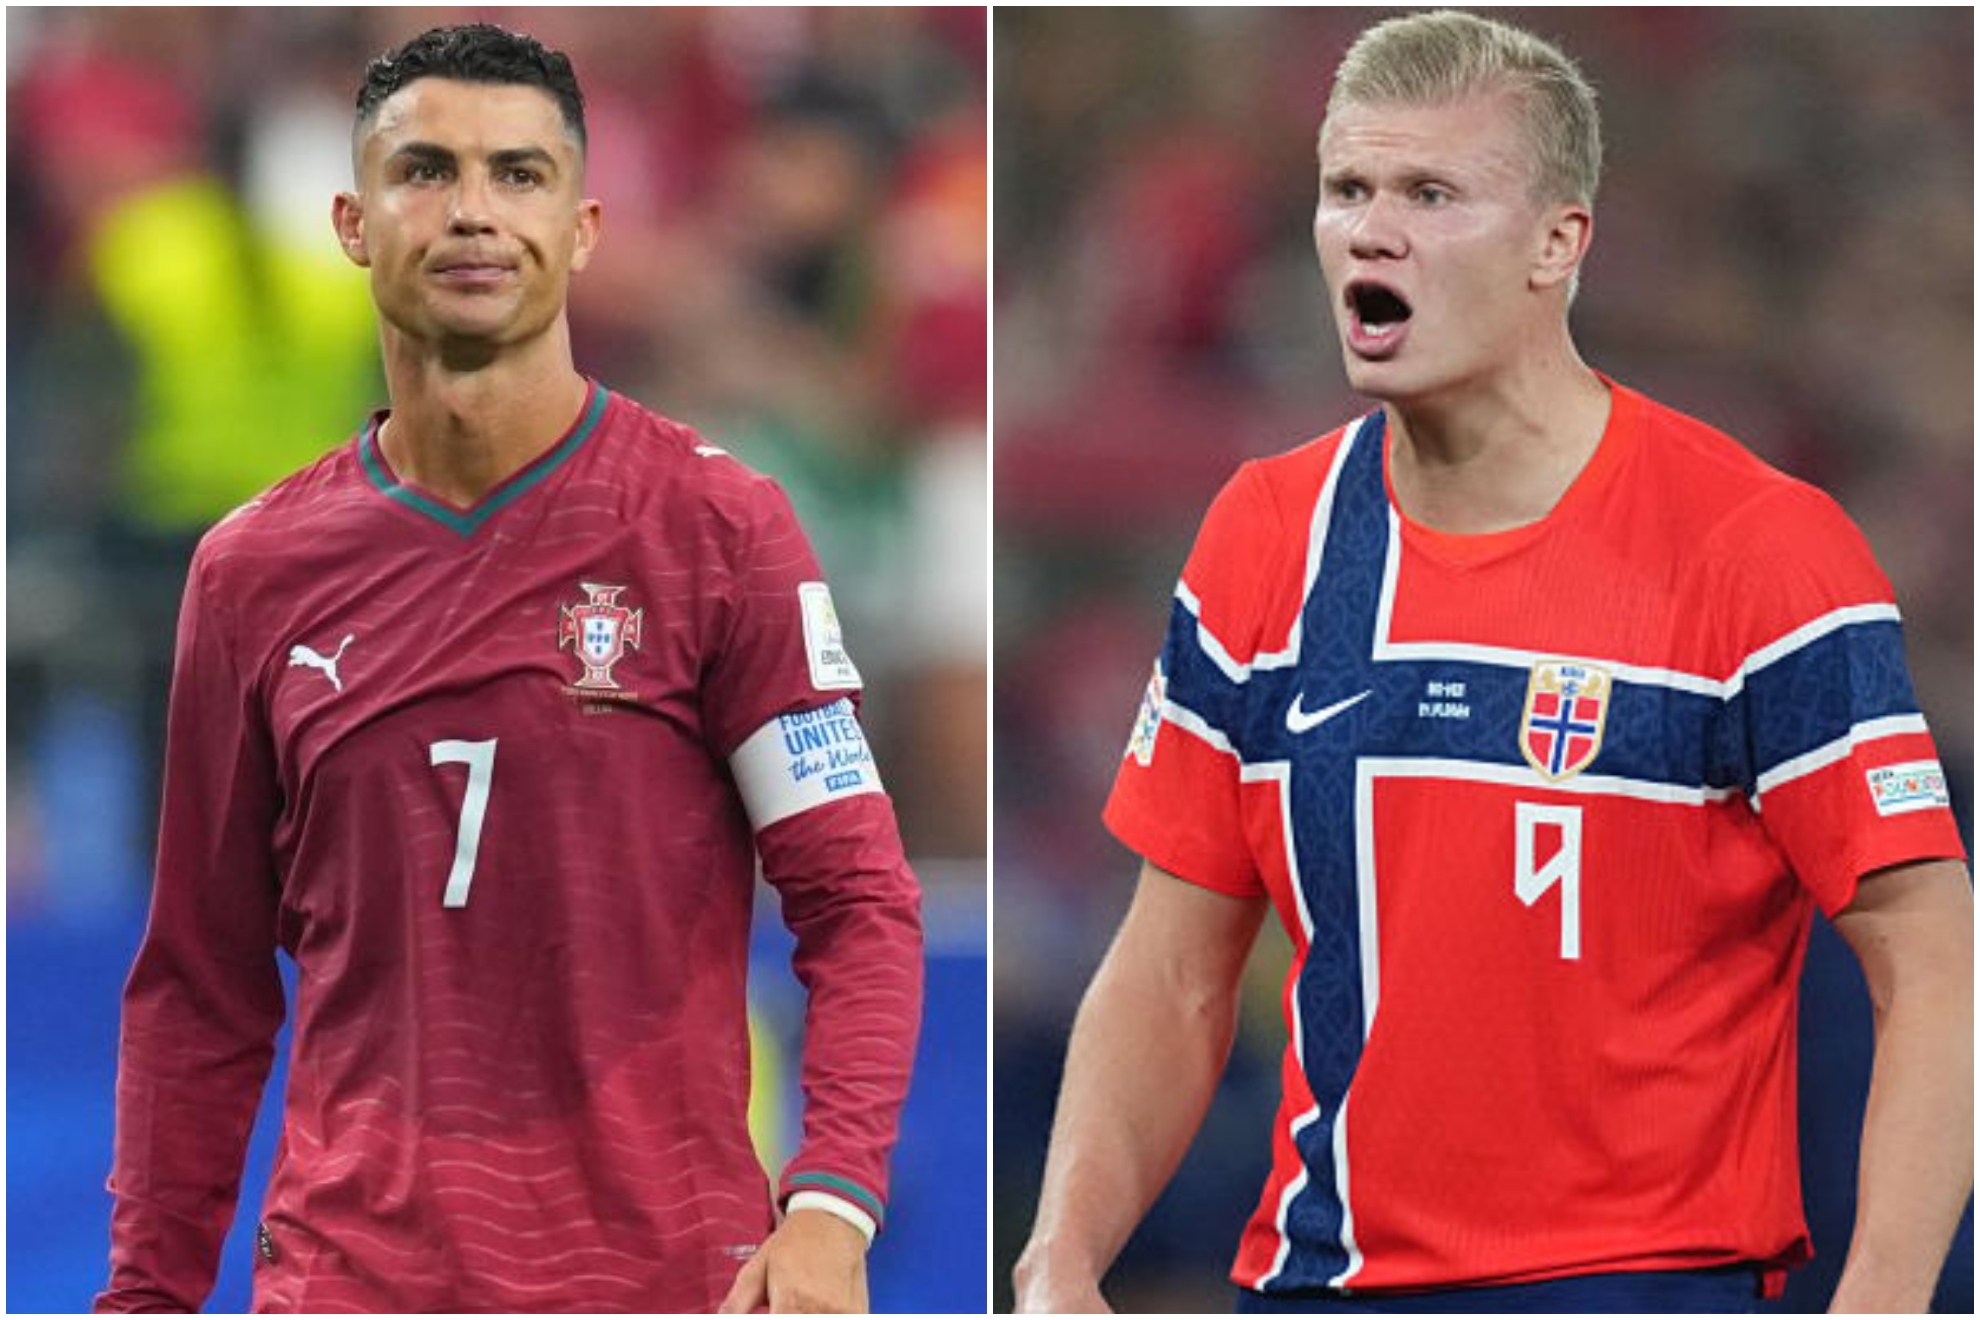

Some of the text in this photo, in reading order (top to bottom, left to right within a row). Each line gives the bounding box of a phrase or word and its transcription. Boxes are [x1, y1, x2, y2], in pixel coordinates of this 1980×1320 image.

[780, 701, 853, 731] FOOTBA
[787, 756, 825, 782] the
[429, 738, 498, 907] 7
[1515, 801, 1583, 959] 9
